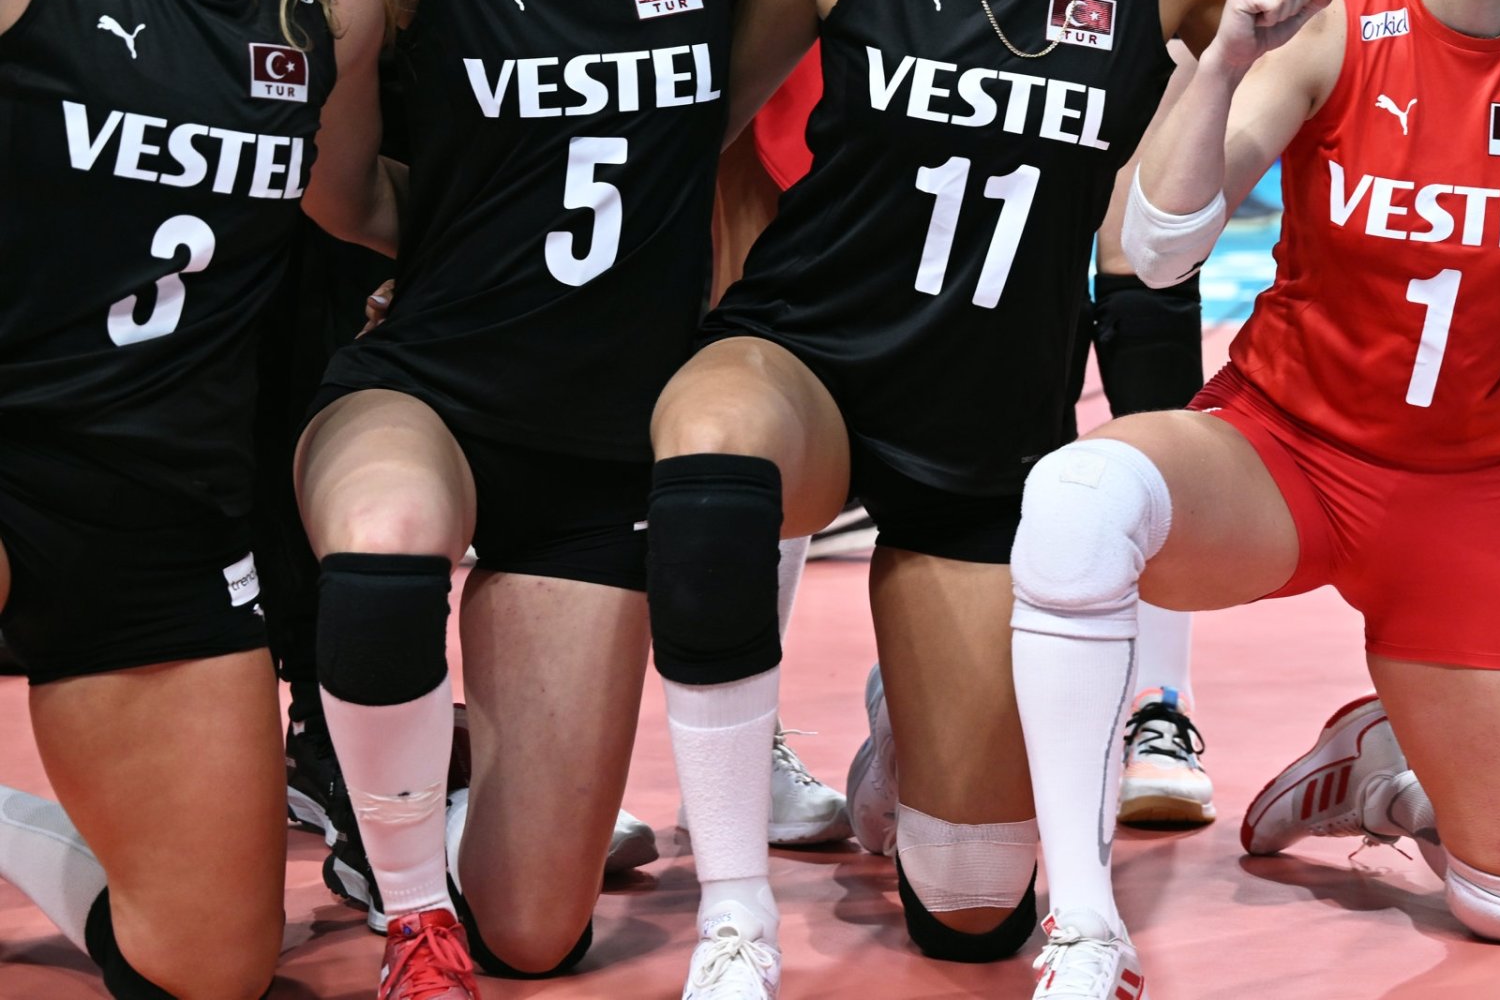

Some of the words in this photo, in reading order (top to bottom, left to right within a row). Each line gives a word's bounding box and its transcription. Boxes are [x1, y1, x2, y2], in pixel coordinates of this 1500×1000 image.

[1064, 31, 1098, 45] TUR
[1362, 13, 1409, 41] Orkid
[265, 84, 295, 97] TUR
[462, 42, 721, 118] VESTEL
[865, 45, 1110, 150] VESTEL
[62, 100, 304, 199] VESTEL
[544, 137, 629, 287] 5
[913, 156, 1041, 310] 11
[106, 214, 216, 347] 3
[1405, 268, 1462, 408] 1
